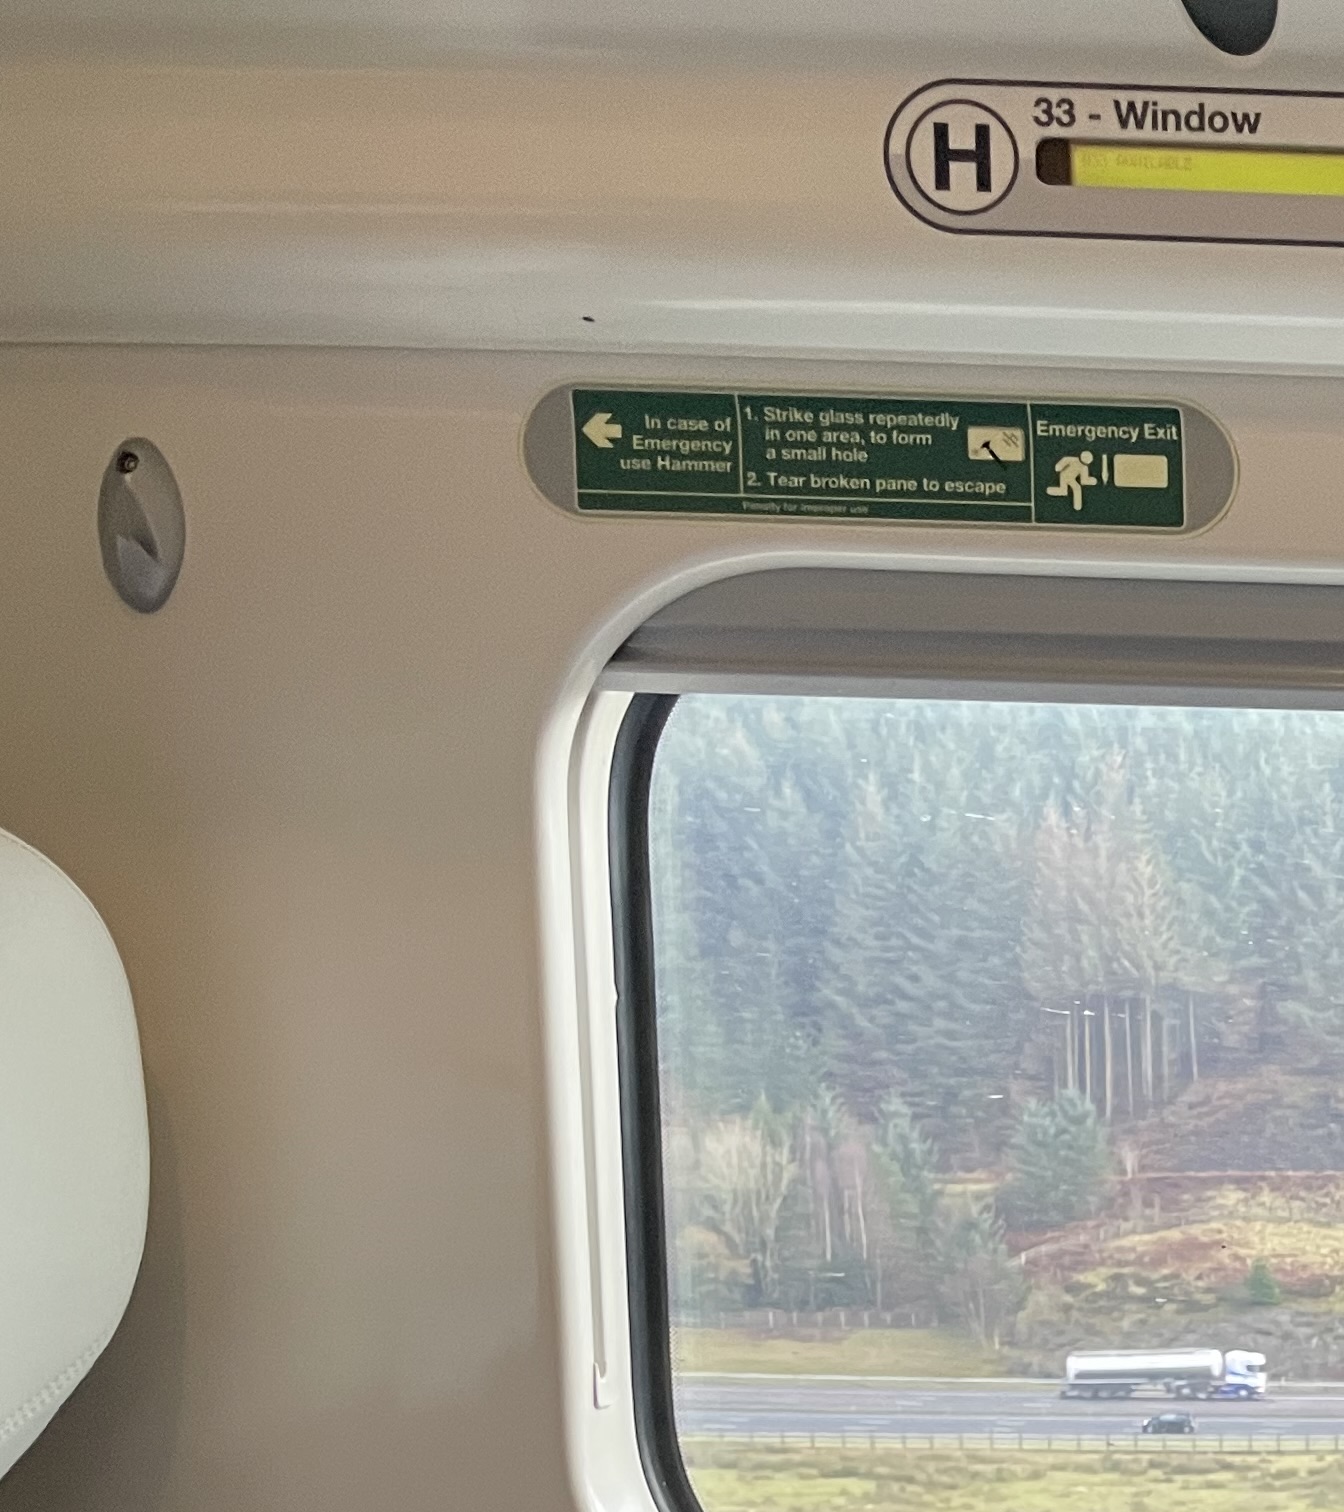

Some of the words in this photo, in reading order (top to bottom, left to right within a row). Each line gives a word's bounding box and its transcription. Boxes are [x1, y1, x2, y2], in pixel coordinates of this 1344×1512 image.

[1032, 98, 1076, 127] 33
[1113, 100, 1262, 135] Window
[933, 122, 992, 192] H
[645, 415, 662, 430] In
[666, 418, 708, 431] case
[714, 417, 732, 432] of
[744, 405, 759, 421] 1.
[763, 406, 814, 423] Strike
[819, 409, 865, 426] glass
[869, 411, 960, 431] repeatedly
[765, 427, 781, 441] in
[785, 430, 818, 442] one
[822, 431, 866, 446] area,
[870, 430, 888, 444] to
[892, 430, 932, 446] form
[1036, 420, 1140, 443] Emergency
[1144, 424, 1178, 441] Exit
[632, 434, 733, 455] Emergency
[765, 448, 777, 460] a
[781, 447, 827, 461] small
[831, 447, 869, 463] hole
[620, 457, 651, 471] use
[657, 457, 732, 473] Hammer
[747, 471, 761, 486] 2.
[766, 472, 807, 487] Tear
[810, 473, 871, 490] broken
[875, 478, 918, 493] pane
[922, 477, 939, 492] to
[944, 481, 1006, 496] escape
